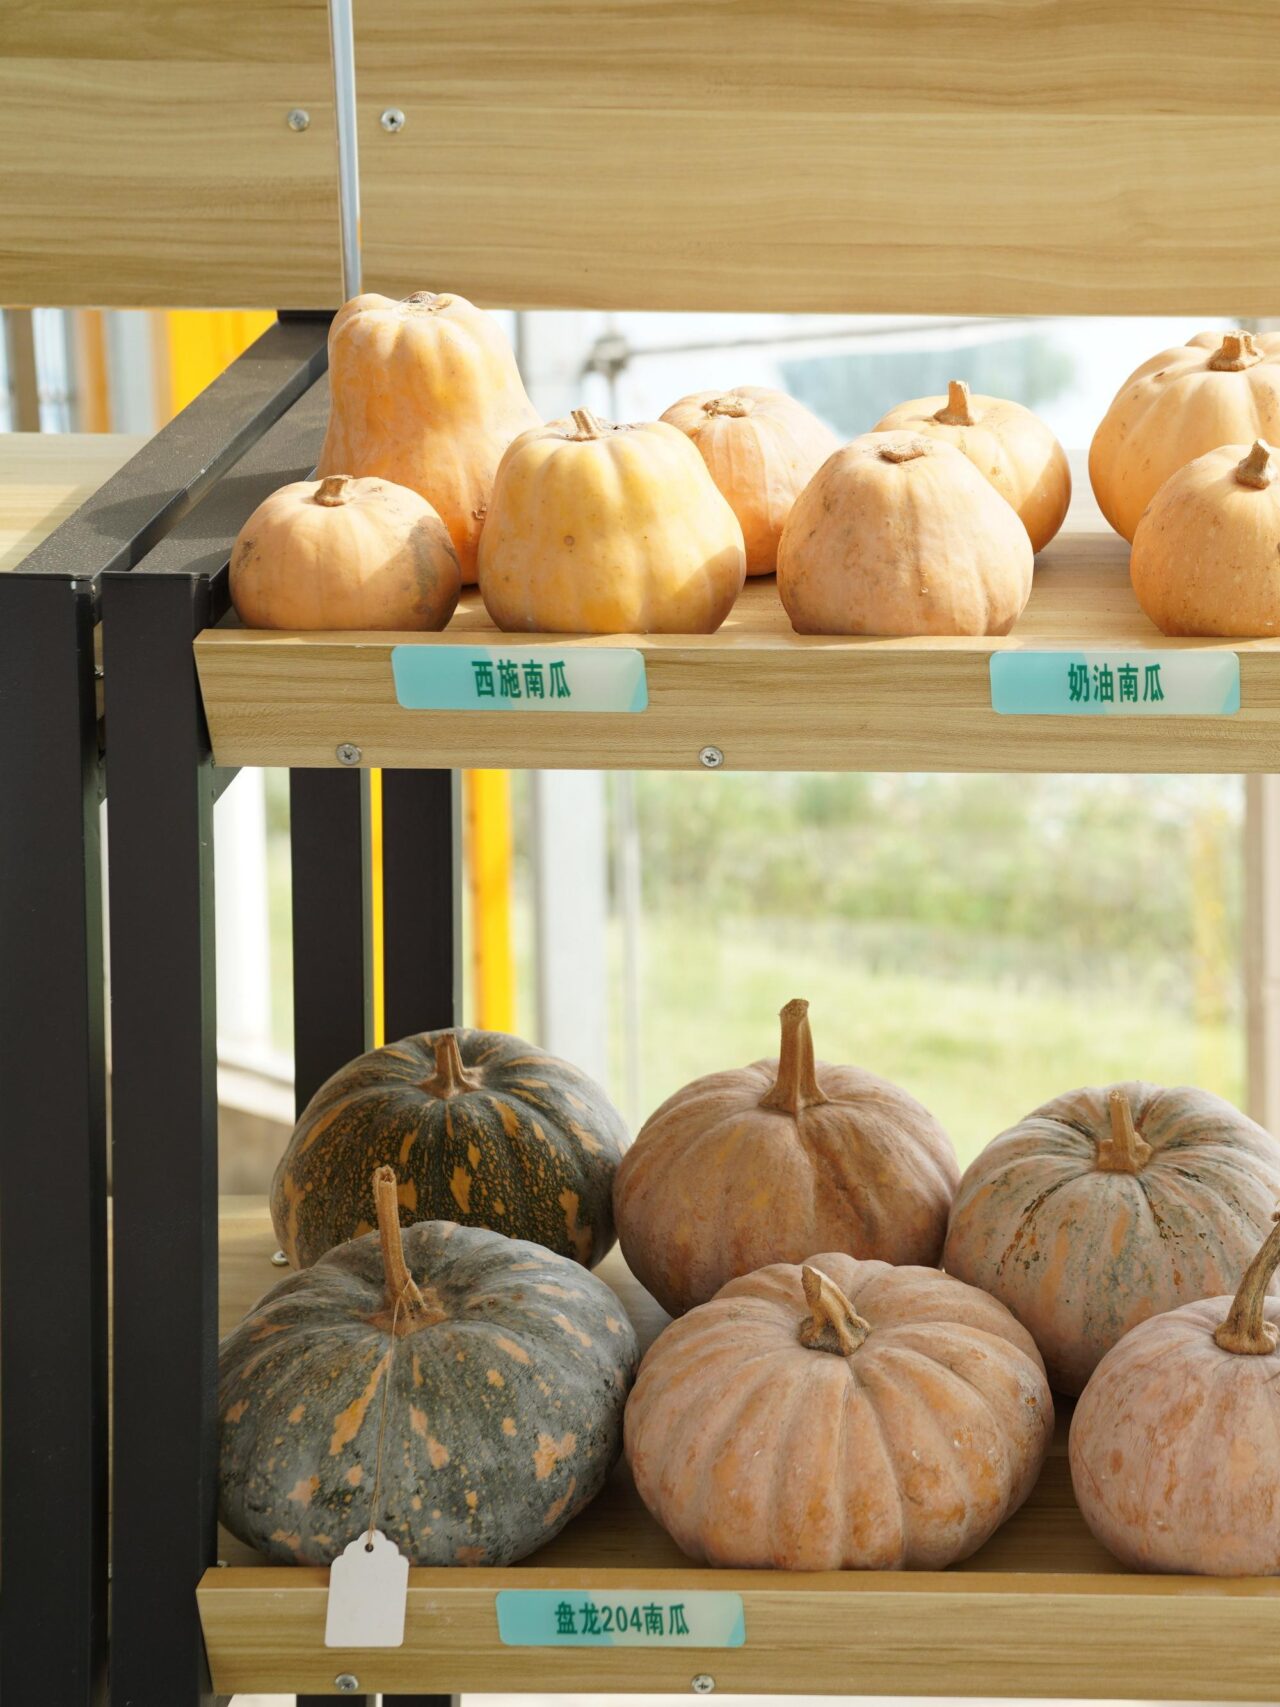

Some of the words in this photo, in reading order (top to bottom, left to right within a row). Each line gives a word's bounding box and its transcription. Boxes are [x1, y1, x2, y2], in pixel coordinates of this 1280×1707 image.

[471, 659, 572, 700] 西施南瓜
[1067, 662, 1165, 703] 奶油南瓜
[553, 1601, 690, 1637] 盘龙204南瓜
